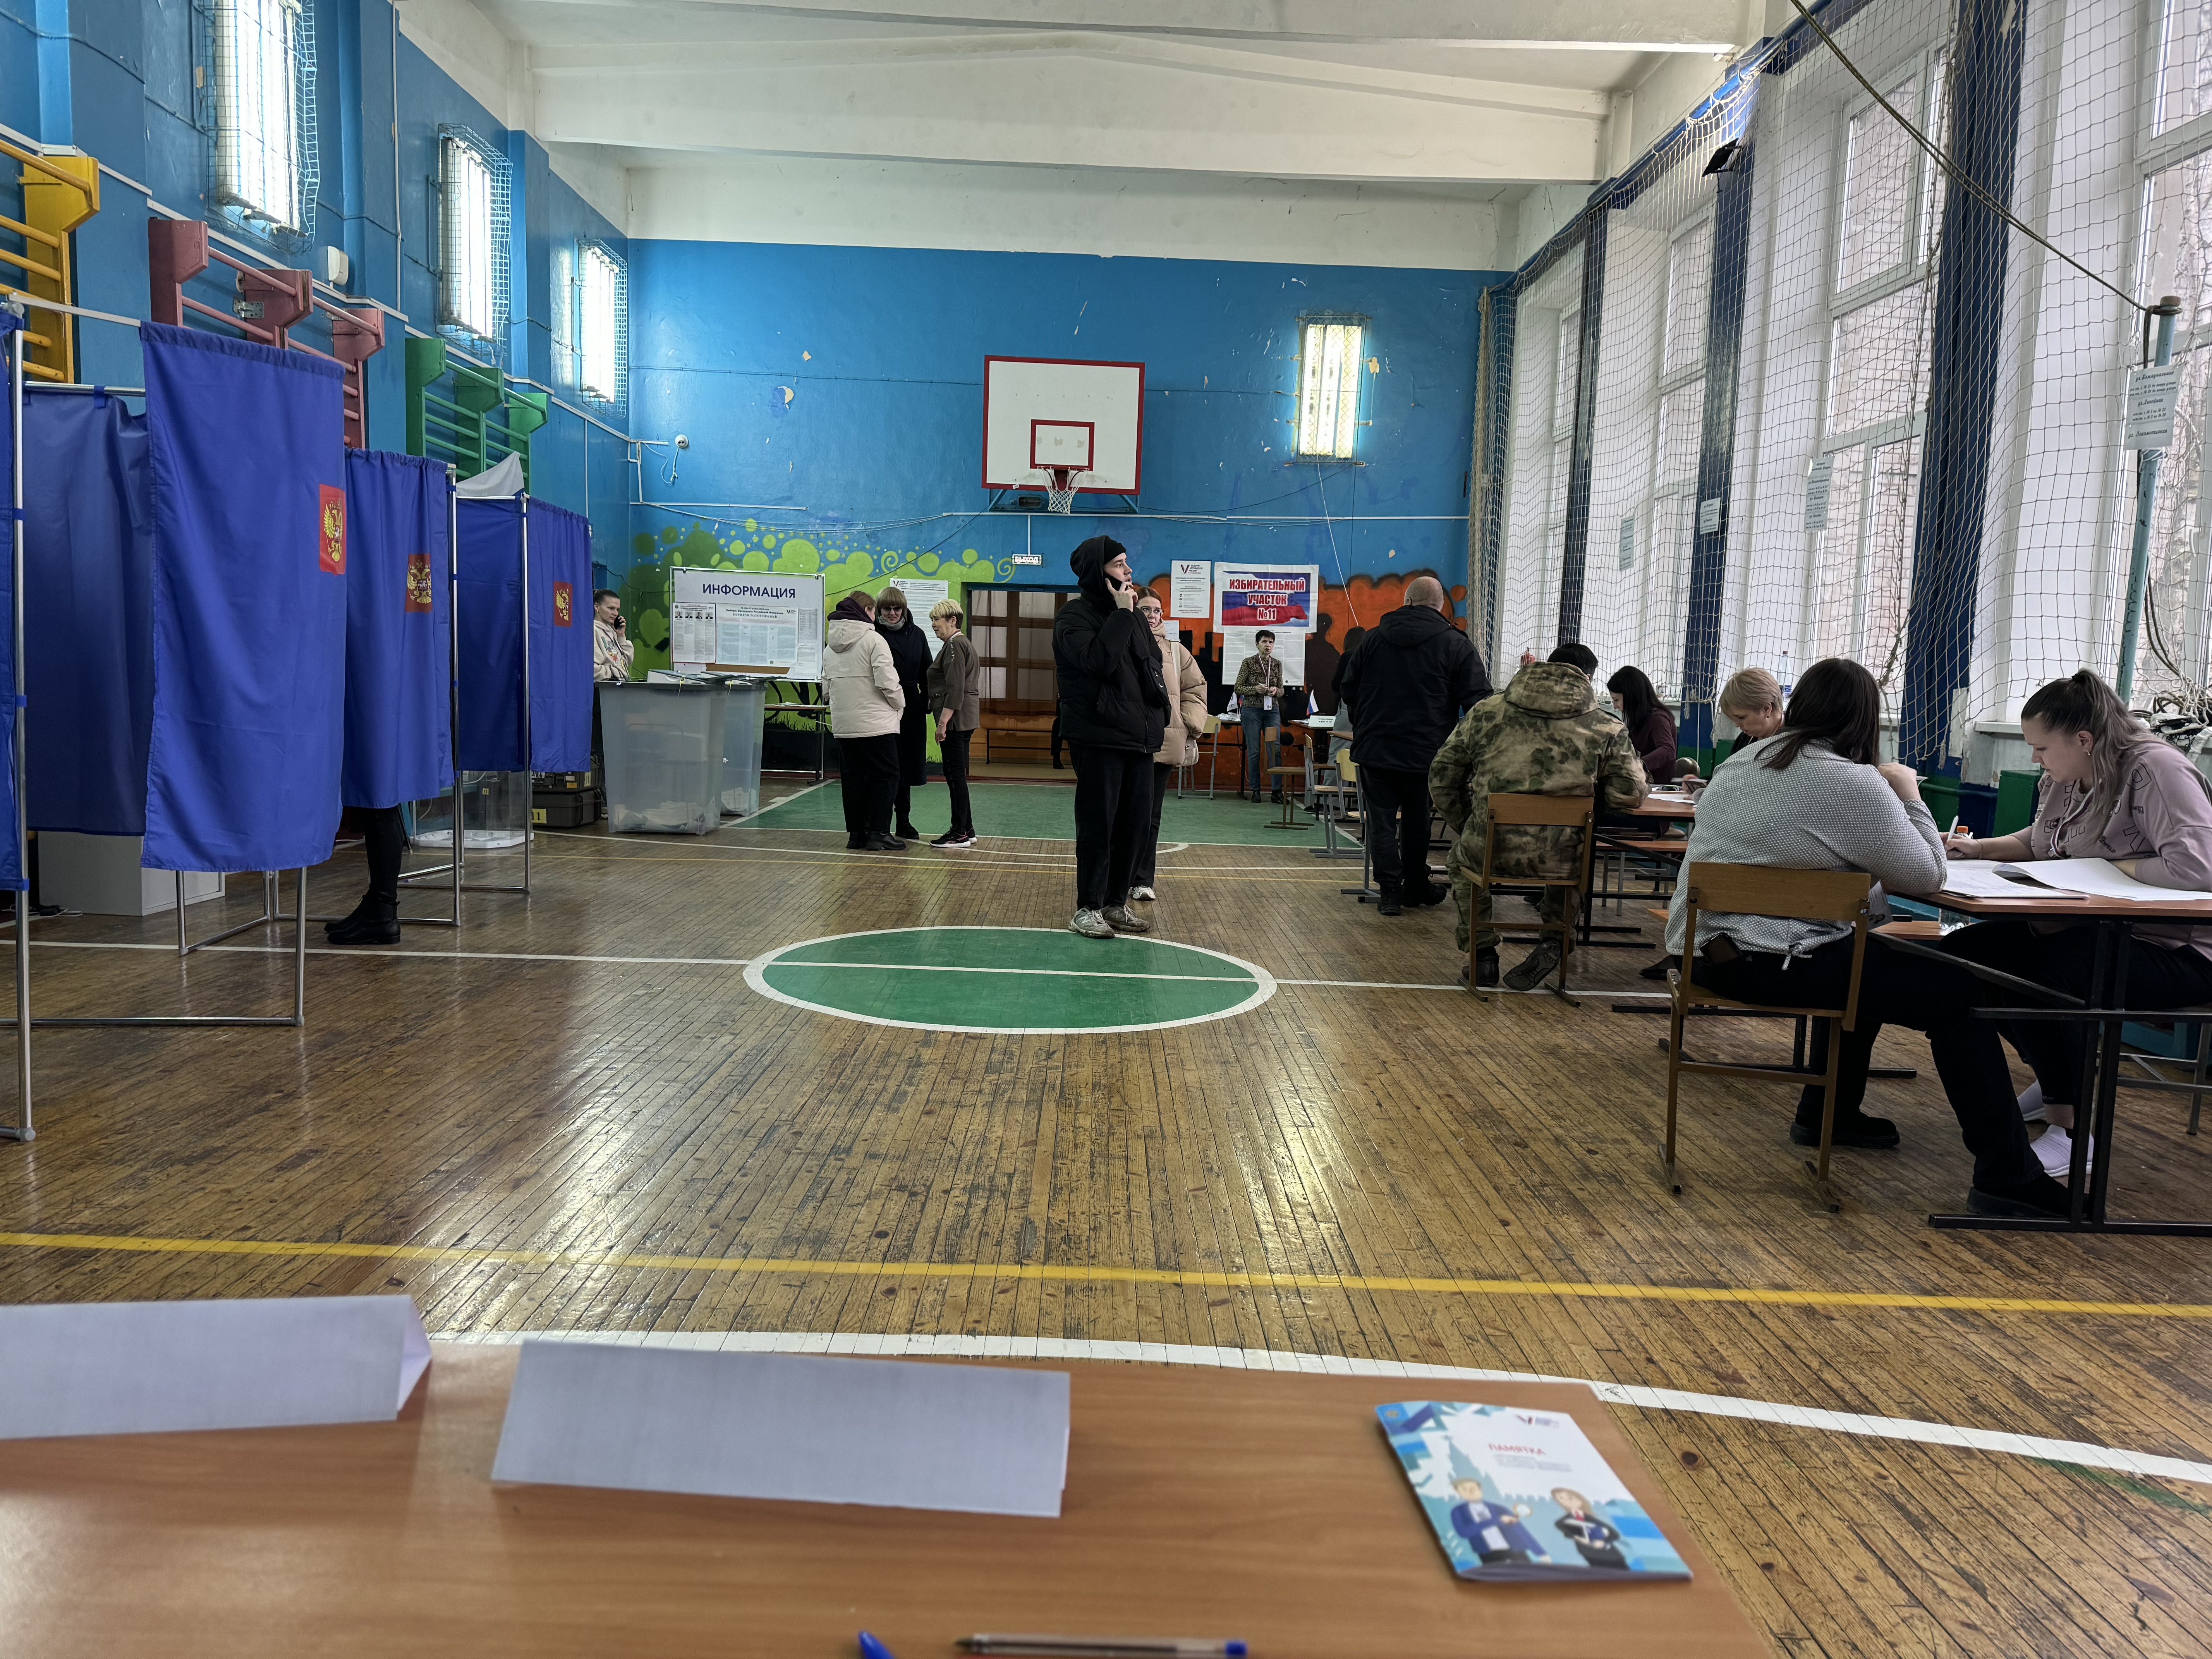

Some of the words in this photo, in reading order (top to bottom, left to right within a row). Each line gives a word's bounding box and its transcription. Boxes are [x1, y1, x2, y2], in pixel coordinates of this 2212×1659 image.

[1229, 578, 1305, 591] ИЗБИРАТЕЛЬНЫЙ
[703, 584, 795, 599] ИНФОРМАЦИЯ
[1248, 594, 1287, 605] УЧАСТОК
[1258, 609, 1276, 619] №11
[1488, 1443, 1546, 1455] ПАМЯТКА
